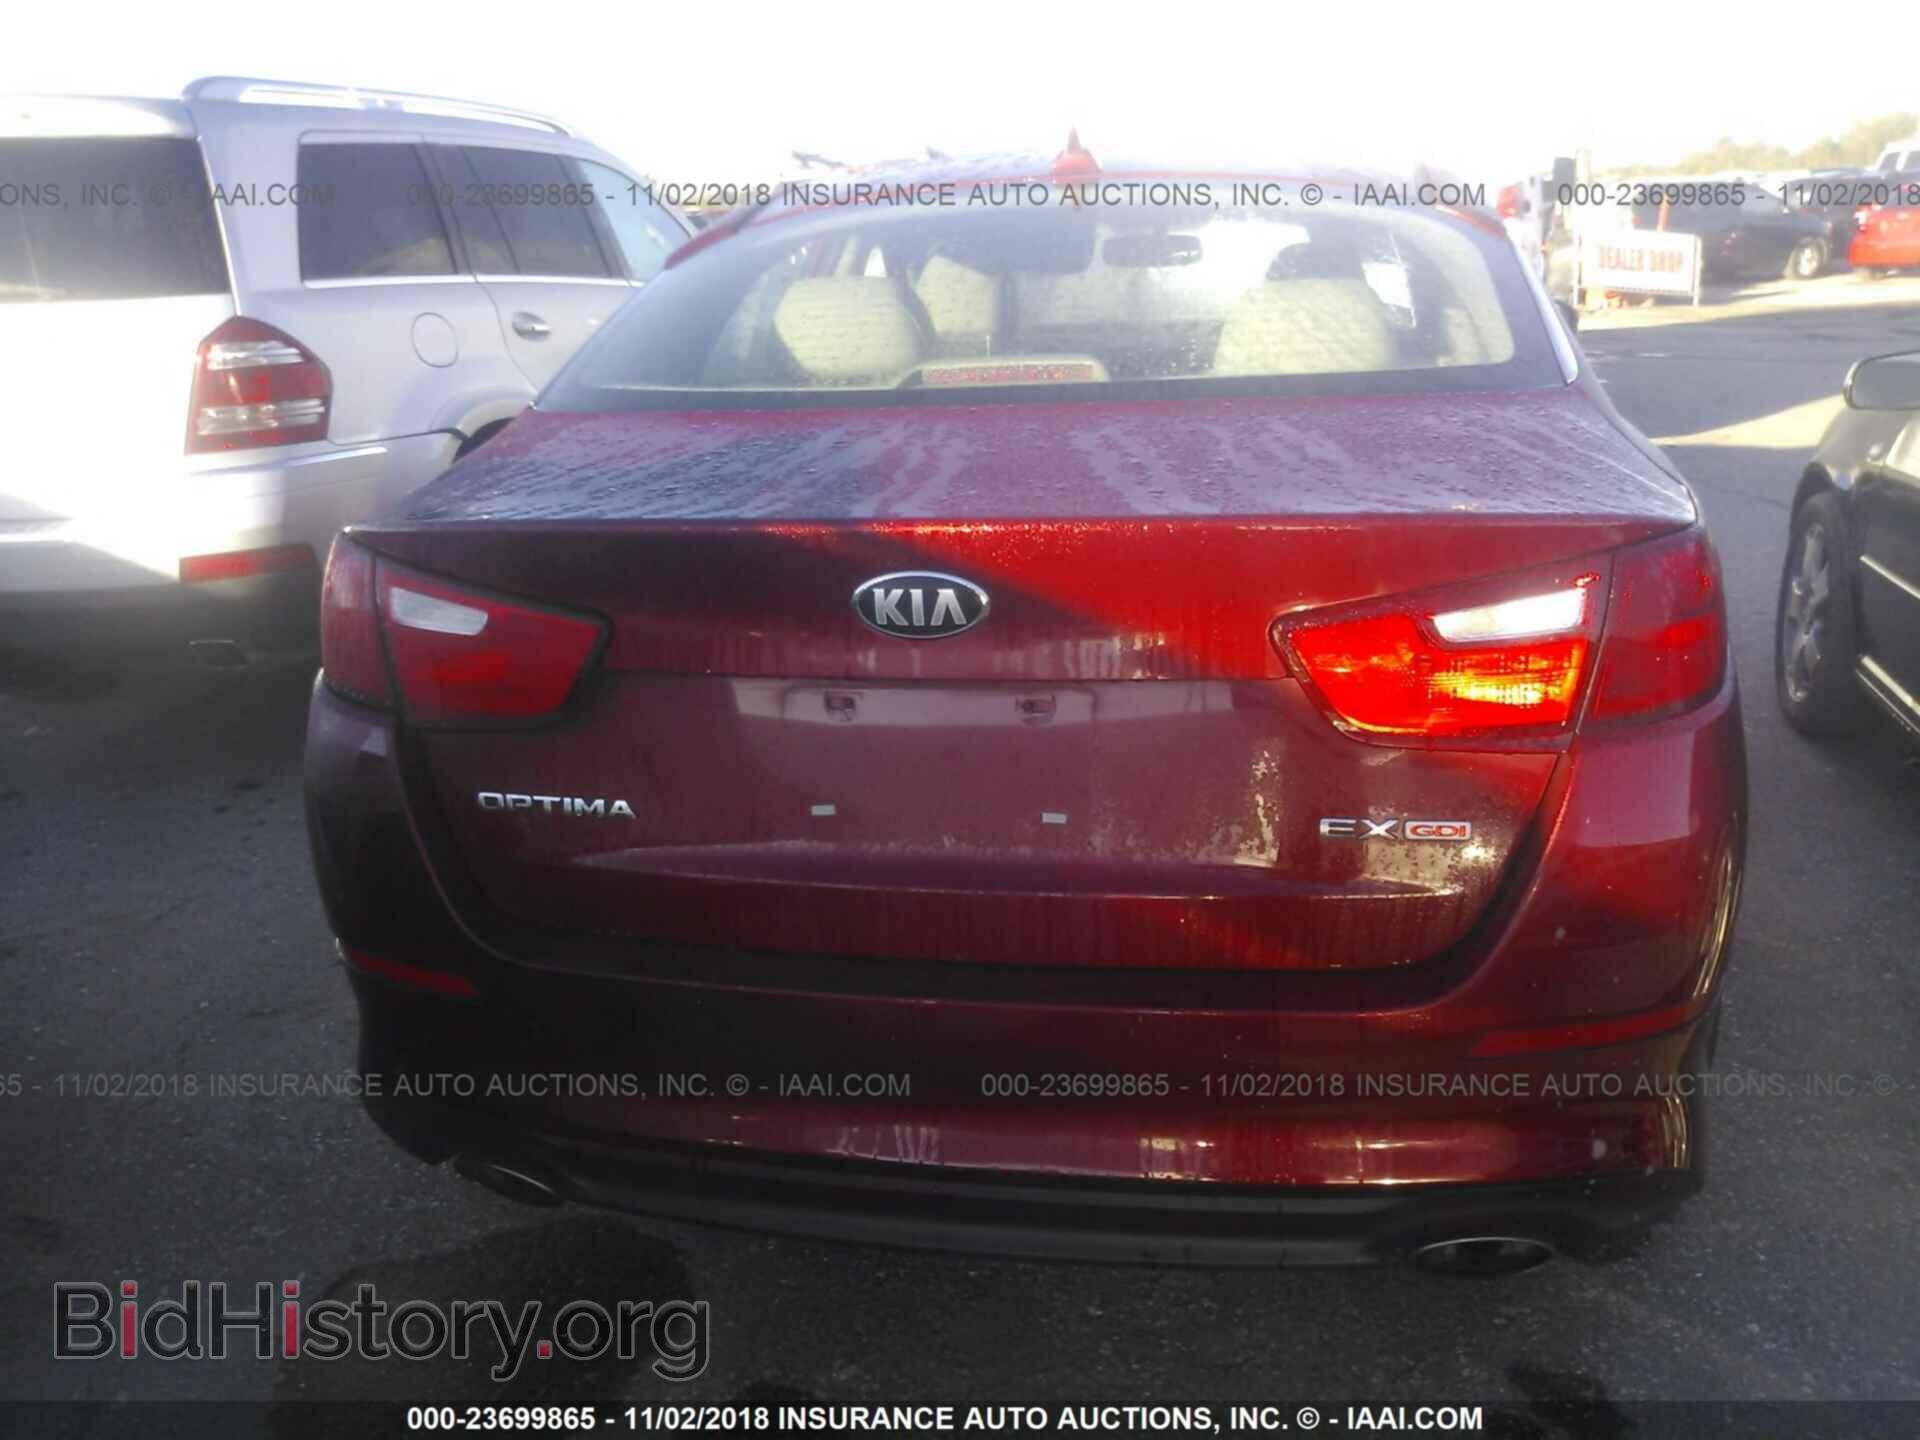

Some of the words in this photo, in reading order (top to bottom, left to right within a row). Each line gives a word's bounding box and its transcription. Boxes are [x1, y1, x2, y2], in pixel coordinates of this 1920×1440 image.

[873, 588, 967, 626] KIA
[477, 791, 637, 819] OPTIMA
[1320, 818, 1399, 840] EX
[1410, 823, 1467, 838] GDI
